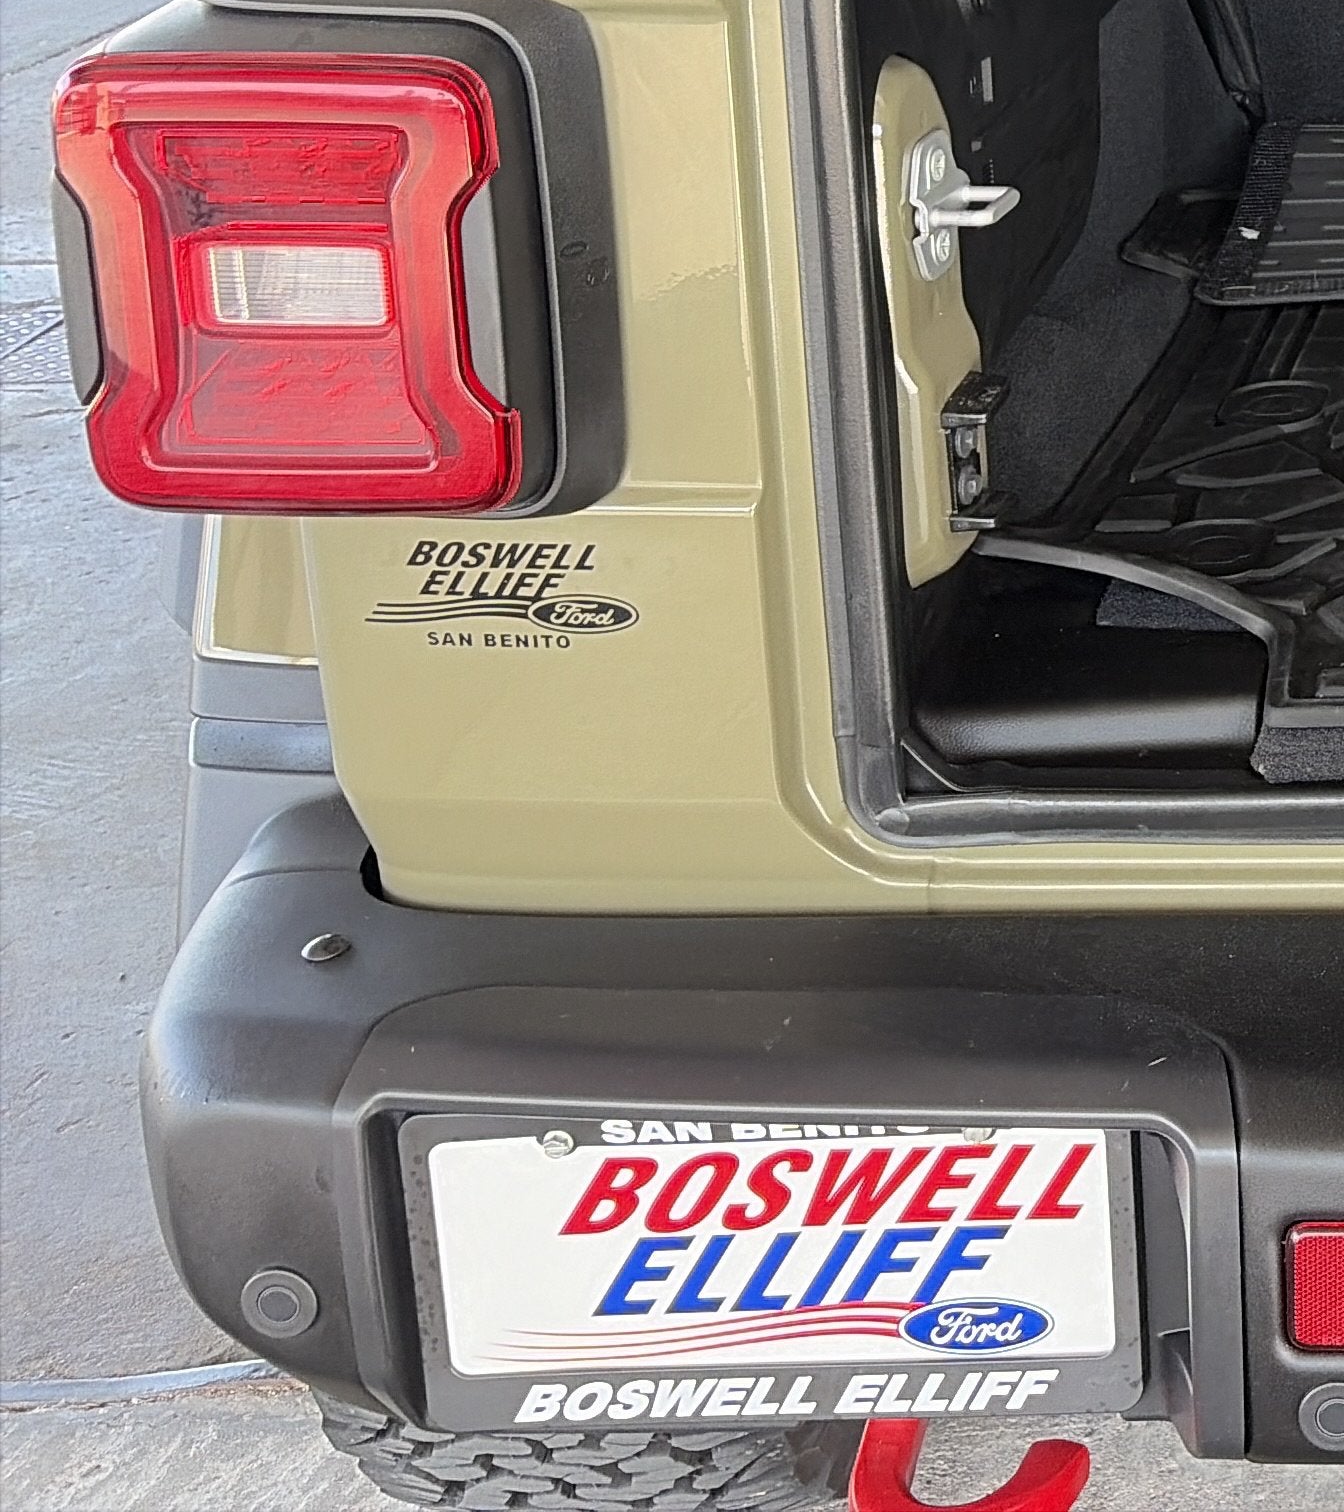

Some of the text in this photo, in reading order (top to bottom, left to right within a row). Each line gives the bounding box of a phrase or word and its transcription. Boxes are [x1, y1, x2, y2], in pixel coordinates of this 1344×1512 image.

[406, 540, 596, 570] BOSWELL
[419, 570, 566, 600] ELLIFF
[550, 601, 615, 626] Ford
[428, 631, 571, 649] SAN BENITO
[600, 1119, 712, 1144] SAN
[559, 1143, 1096, 1236] BOSWELL
[592, 1225, 1013, 1317] ELLIFF
[929, 1307, 1023, 1347] Ford
[514, 1370, 1060, 1425] BOSWELL ELLIFF
